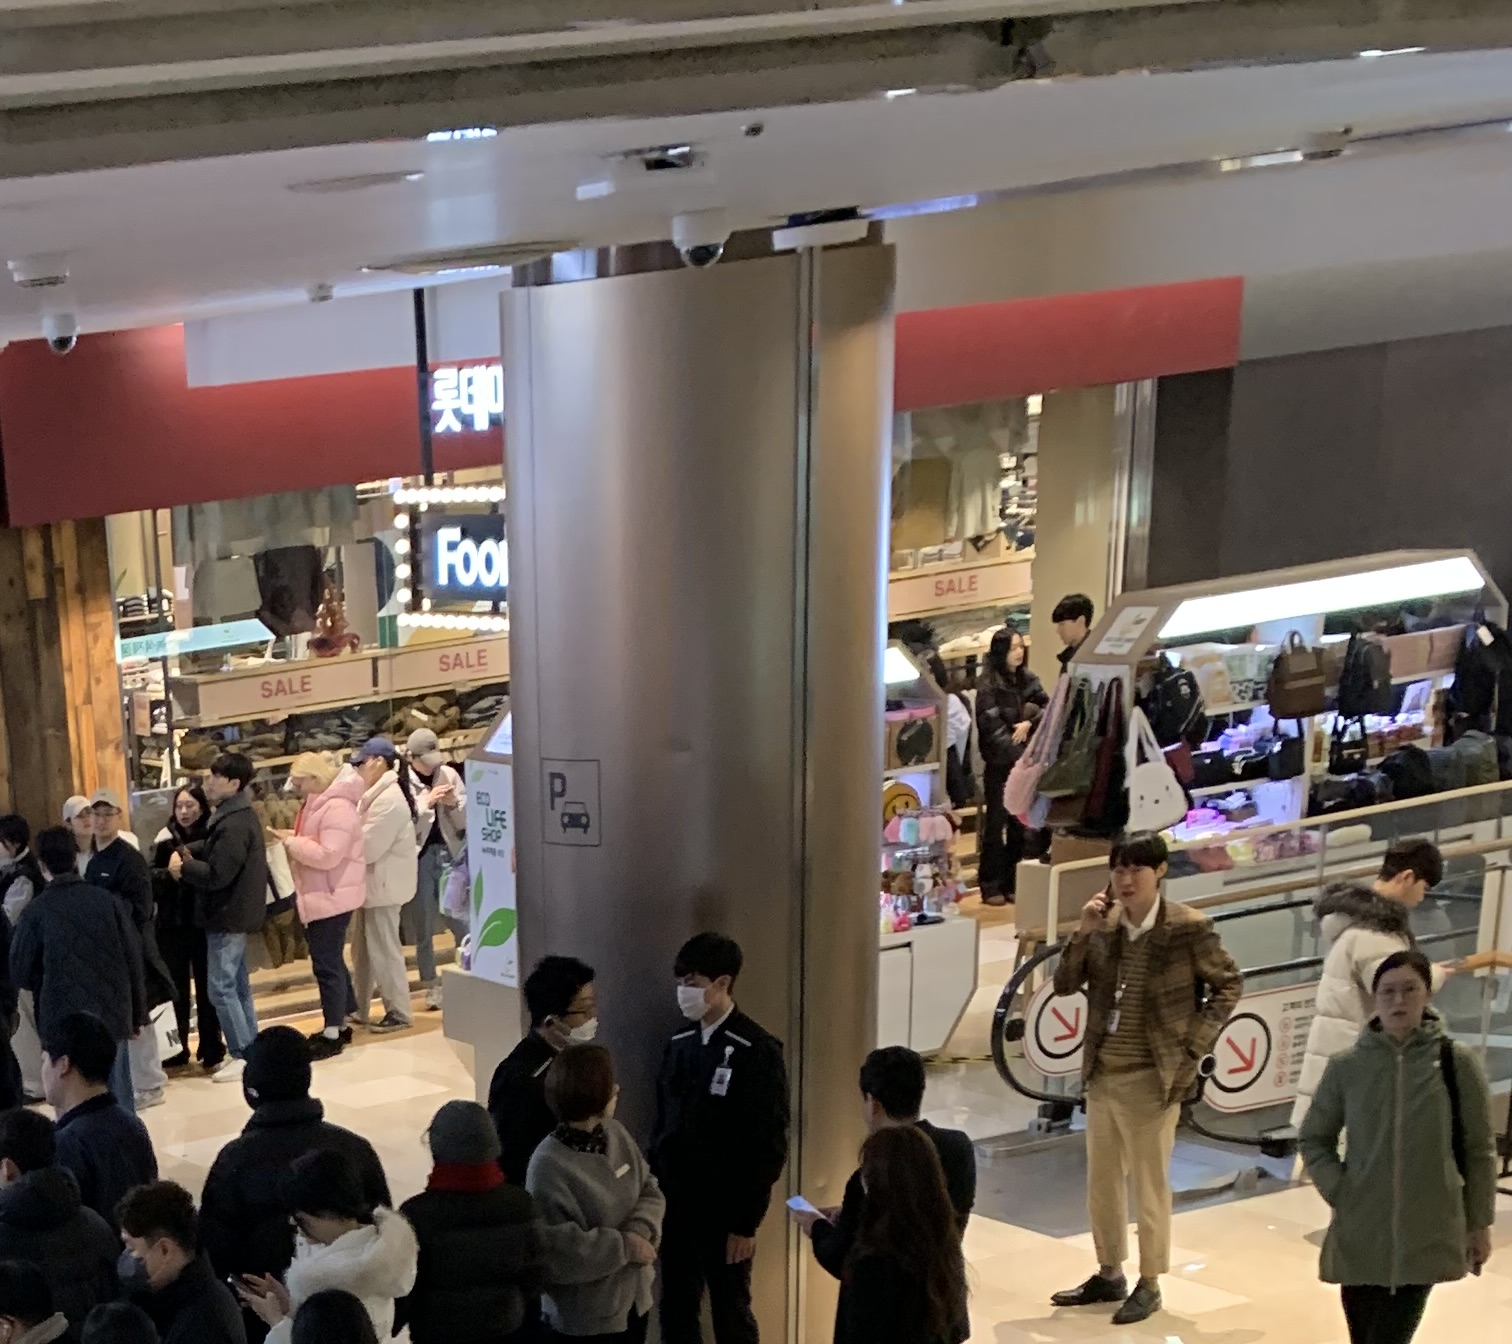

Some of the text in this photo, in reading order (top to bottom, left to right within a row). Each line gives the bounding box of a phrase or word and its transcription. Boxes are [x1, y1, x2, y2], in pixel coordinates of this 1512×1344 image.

[935, 575, 978, 597] SALE
[439, 648, 488, 672] SALE
[261, 675, 312, 699] SALE
[549, 772, 567, 810] P
[481, 827, 503, 842] SHOP
